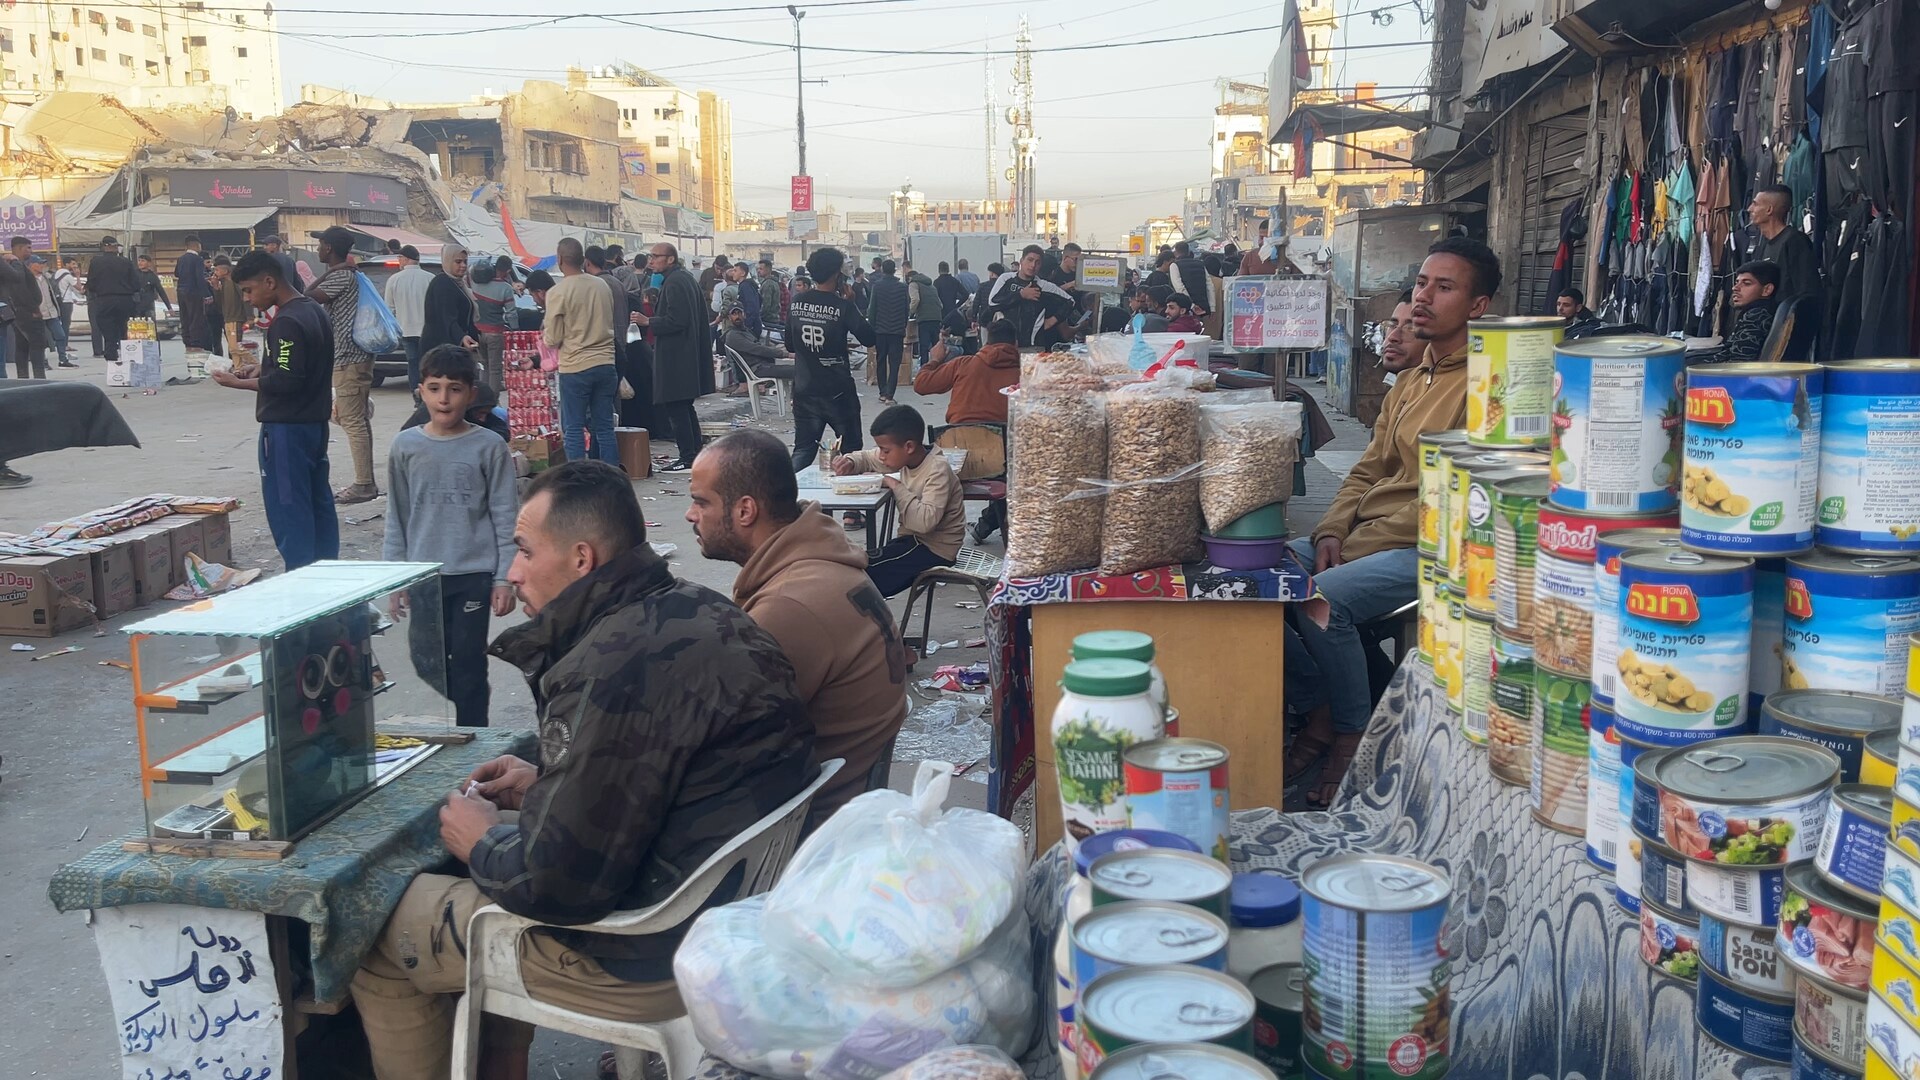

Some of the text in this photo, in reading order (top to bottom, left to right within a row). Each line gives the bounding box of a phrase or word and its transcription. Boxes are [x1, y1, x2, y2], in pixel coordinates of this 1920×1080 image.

[797, 196, 805, 205] 2
[29, 218, 47, 231] زين
[1265, 288, 1290, 299] إمكانية
[790, 302, 841, 317] BALENCIAGA
[1266, 302, 1321, 313] البيع عبر التطبيق
[1703, 389, 1726, 398] RONA
[1702, 437, 1743, 449] פטריות
[1766, 503, 1781, 513] ללא
[1758, 512, 1777, 520] חומר
[1751, 519, 1775, 527] משמר
[1706, 533, 1717, 542] גרם
[1717, 534, 1731, 543] 400
[9, 572, 34, 589] Day
[1663, 586, 1690, 596] RONA
[1631, 591, 1687, 616] רונה
[1662, 633, 1706, 646] פטריות
[1634, 643, 1678, 658] חתוכות
[1683, 731, 1696, 739] 400
[1820, 739, 1852, 752] TUNA
[1063, 749, 1118, 765] SESAME
[1066, 760, 1119, 780] TAHINI
[1801, 817, 1814, 827] 160
[1708, 824, 1715, 834] 3
[1804, 842, 1817, 852] 104
[1731, 935, 1777, 964] Sasu
[1731, 952, 1777, 980] TON
